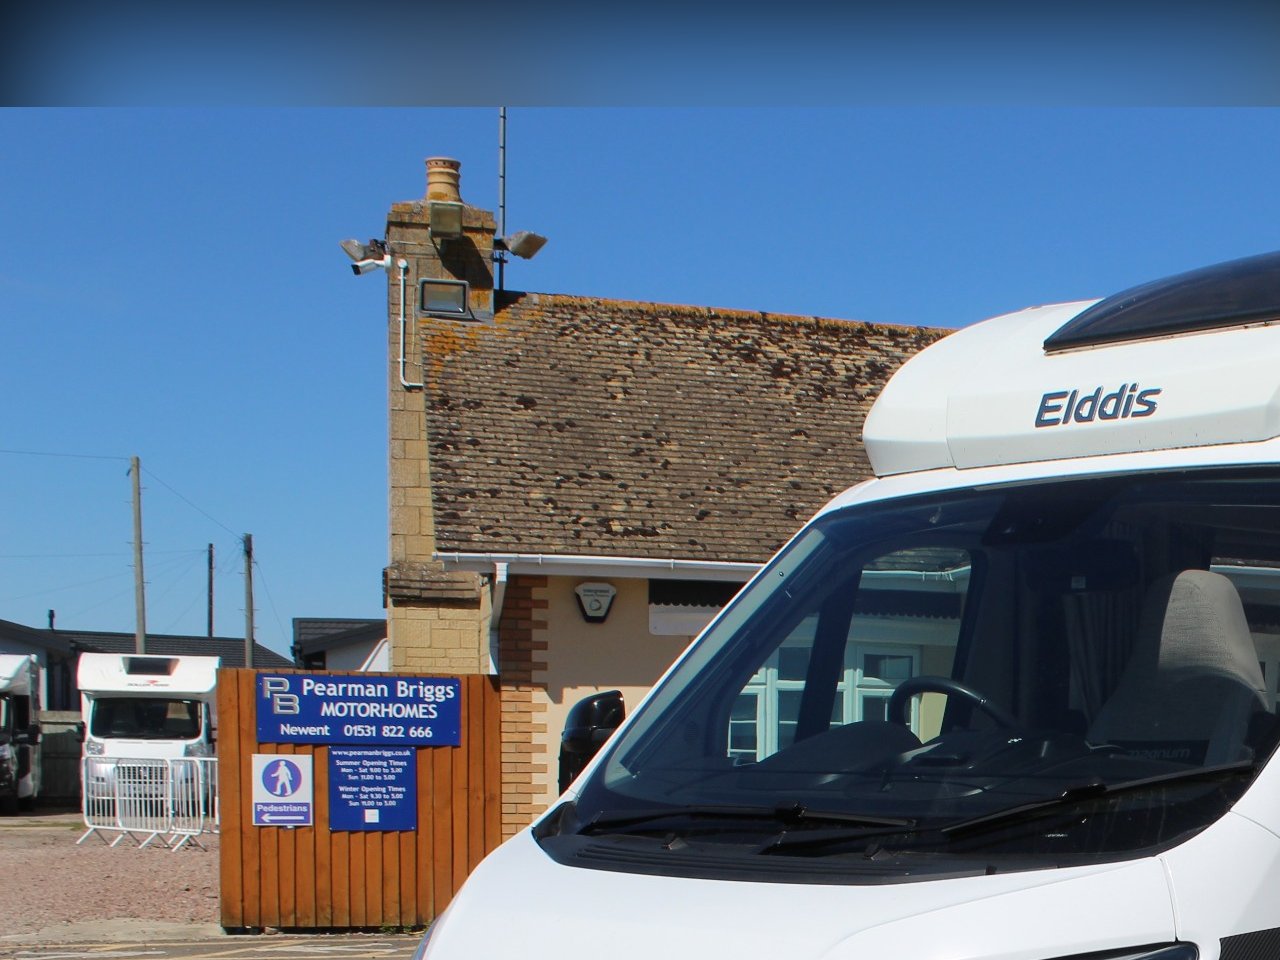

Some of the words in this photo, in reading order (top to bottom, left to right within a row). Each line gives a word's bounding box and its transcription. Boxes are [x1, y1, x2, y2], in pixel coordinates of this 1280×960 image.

[1034, 382, 1163, 428] Elddis
[303, 679, 389, 698] Pearman
[397, 681, 455, 702] Briggs
[320, 702, 438, 719] MOTORHOMES
[280, 723, 331, 736] Newent
[344, 725, 376, 737] 01531
[382, 726, 405, 738] 822
[409, 726, 433, 738] 666
[256, 804, 308, 812] Pedestrians
